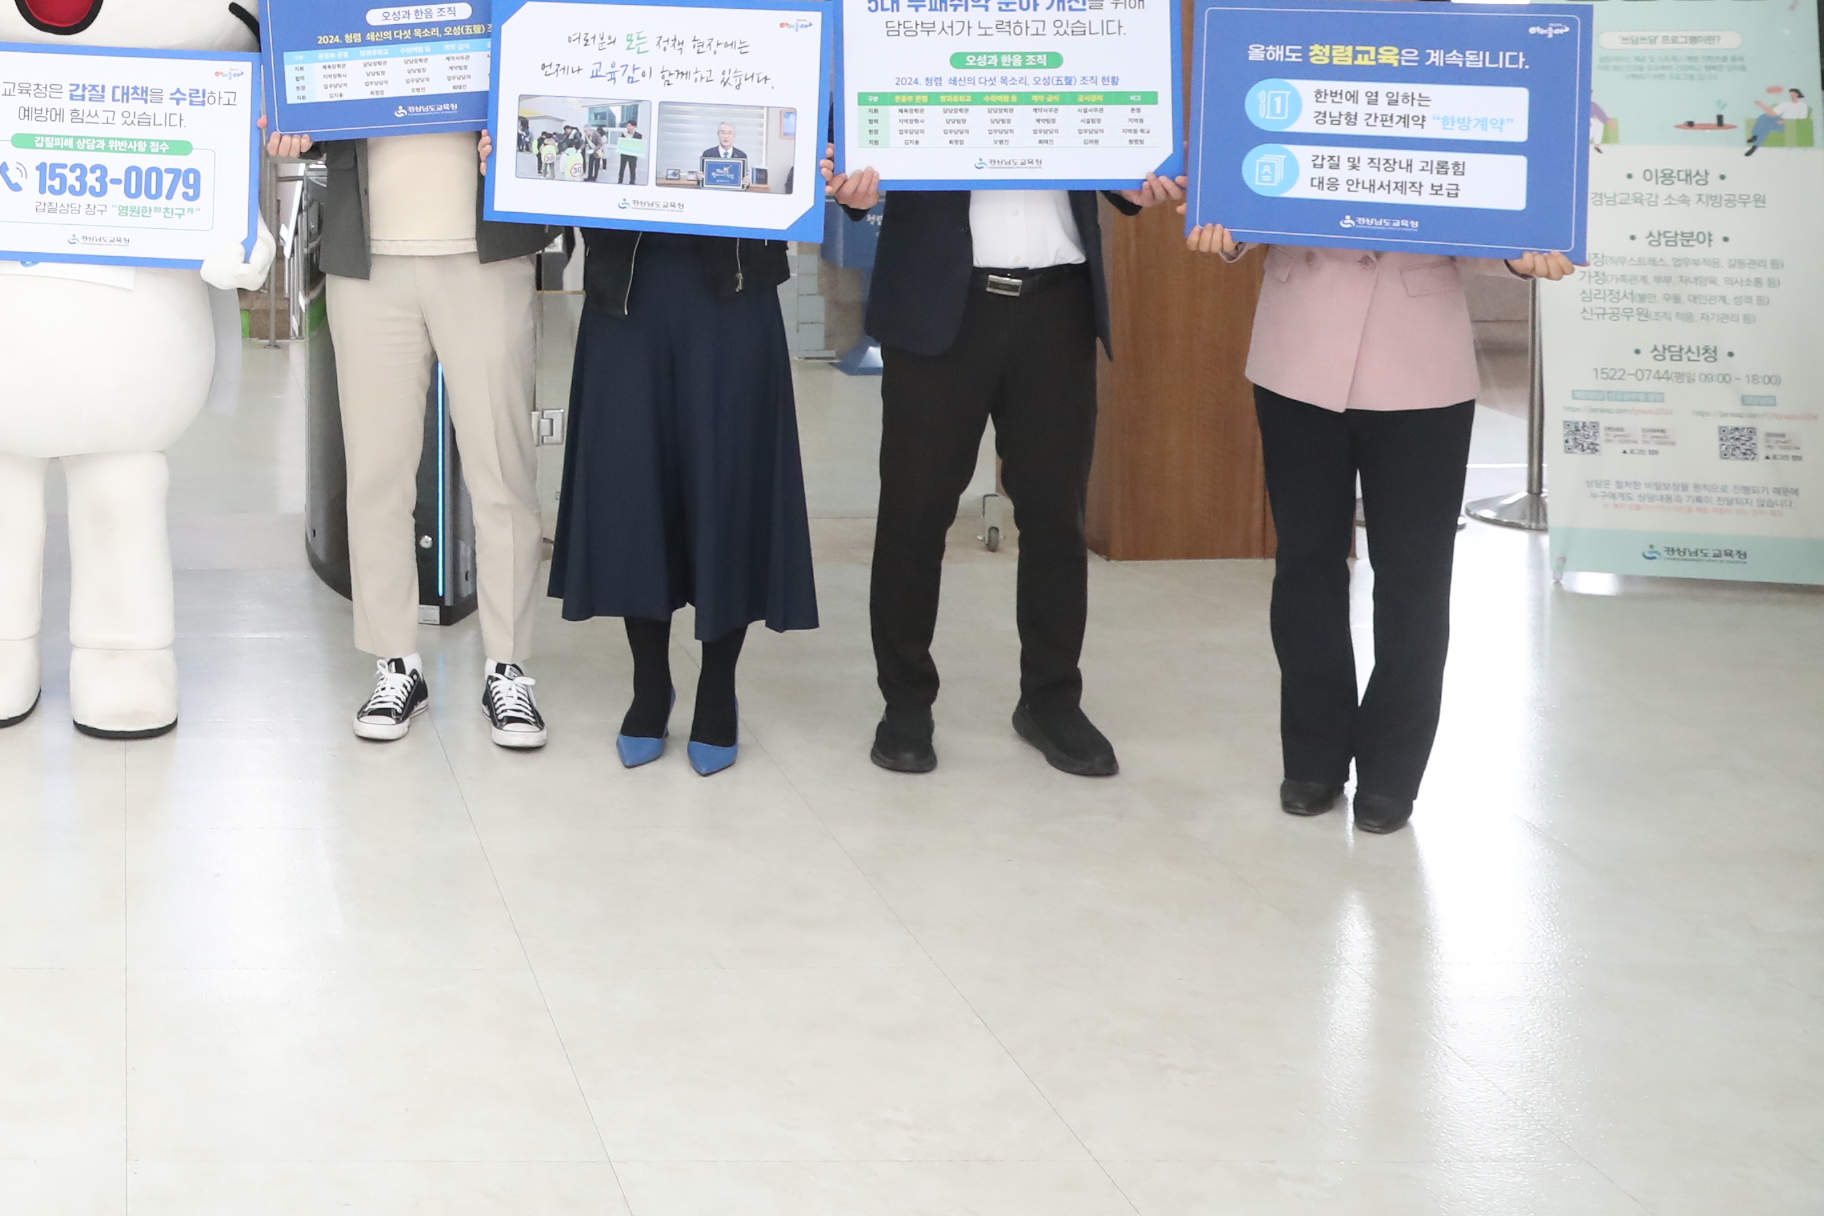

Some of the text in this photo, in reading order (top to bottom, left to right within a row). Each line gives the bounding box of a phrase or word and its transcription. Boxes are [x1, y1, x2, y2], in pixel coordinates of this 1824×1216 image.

[382, 6, 456, 22] 오성과 한음 조직
[885, 19, 1126, 37] 담당부서가 노력하고 있습니다.
[567, 31, 750, 55] 여러분의 모든 정책 현장에는
[965, 53, 1047, 66] 오성과 한음 조직
[1248, 44, 1529, 69] 올해도 청렴교육은 계속됩니다.
[540, 61, 775, 90] 언제나 교육감이 함께하고 있습니다.
[894, 77, 922, 86] 2024.
[925, 76, 943, 87] 청렴
[948, 75, 976, 86] 쇄신의
[978, 75, 996, 87] 다섯
[999, 75, 1030, 86] 목소리,
[1080, 75, 1098, 86] 조직
[1100, 75, 1119, 86] 현황
[69, 82, 105, 102] 갑질
[112, 85, 164, 104] 대책을
[169, 88, 237, 107] 수립하고
[1314, 88, 1432, 107] 한번에 열 일하는
[18, 107, 186, 129] 예방에 힘쓰고 있습니다.
[408, 103, 458, 115] 경상남도교육청
[1313, 110, 1358, 126] 경남형
[1364, 112, 1427, 130] 간편계약
[35, 135, 169, 153] 갑질피해 상담과 위반사항 접수
[988, 158, 1042, 167] 경상남도교육청
[1311, 153, 1466, 176] 갑질 및 직장내 괴롭힘
[35, 161, 201, 202] 1533-0079
[1643, 169, 1709, 185] 이용대상
[1311, 176, 1460, 199] 대응 안내서제작 보급
[35, 201, 107, 216] 갑질상담 창구
[1590, 193, 1767, 209] 경남교육감 소속 지방공무원
[1646, 230, 1713, 247] 상담분야
[1650, 344, 1718, 363] 상담신청
[1699, 374, 1732, 383] 09:00
[1745, 374, 1781, 386] 18:00)
[1664, 546, 1747, 559] 경상남도교육청
